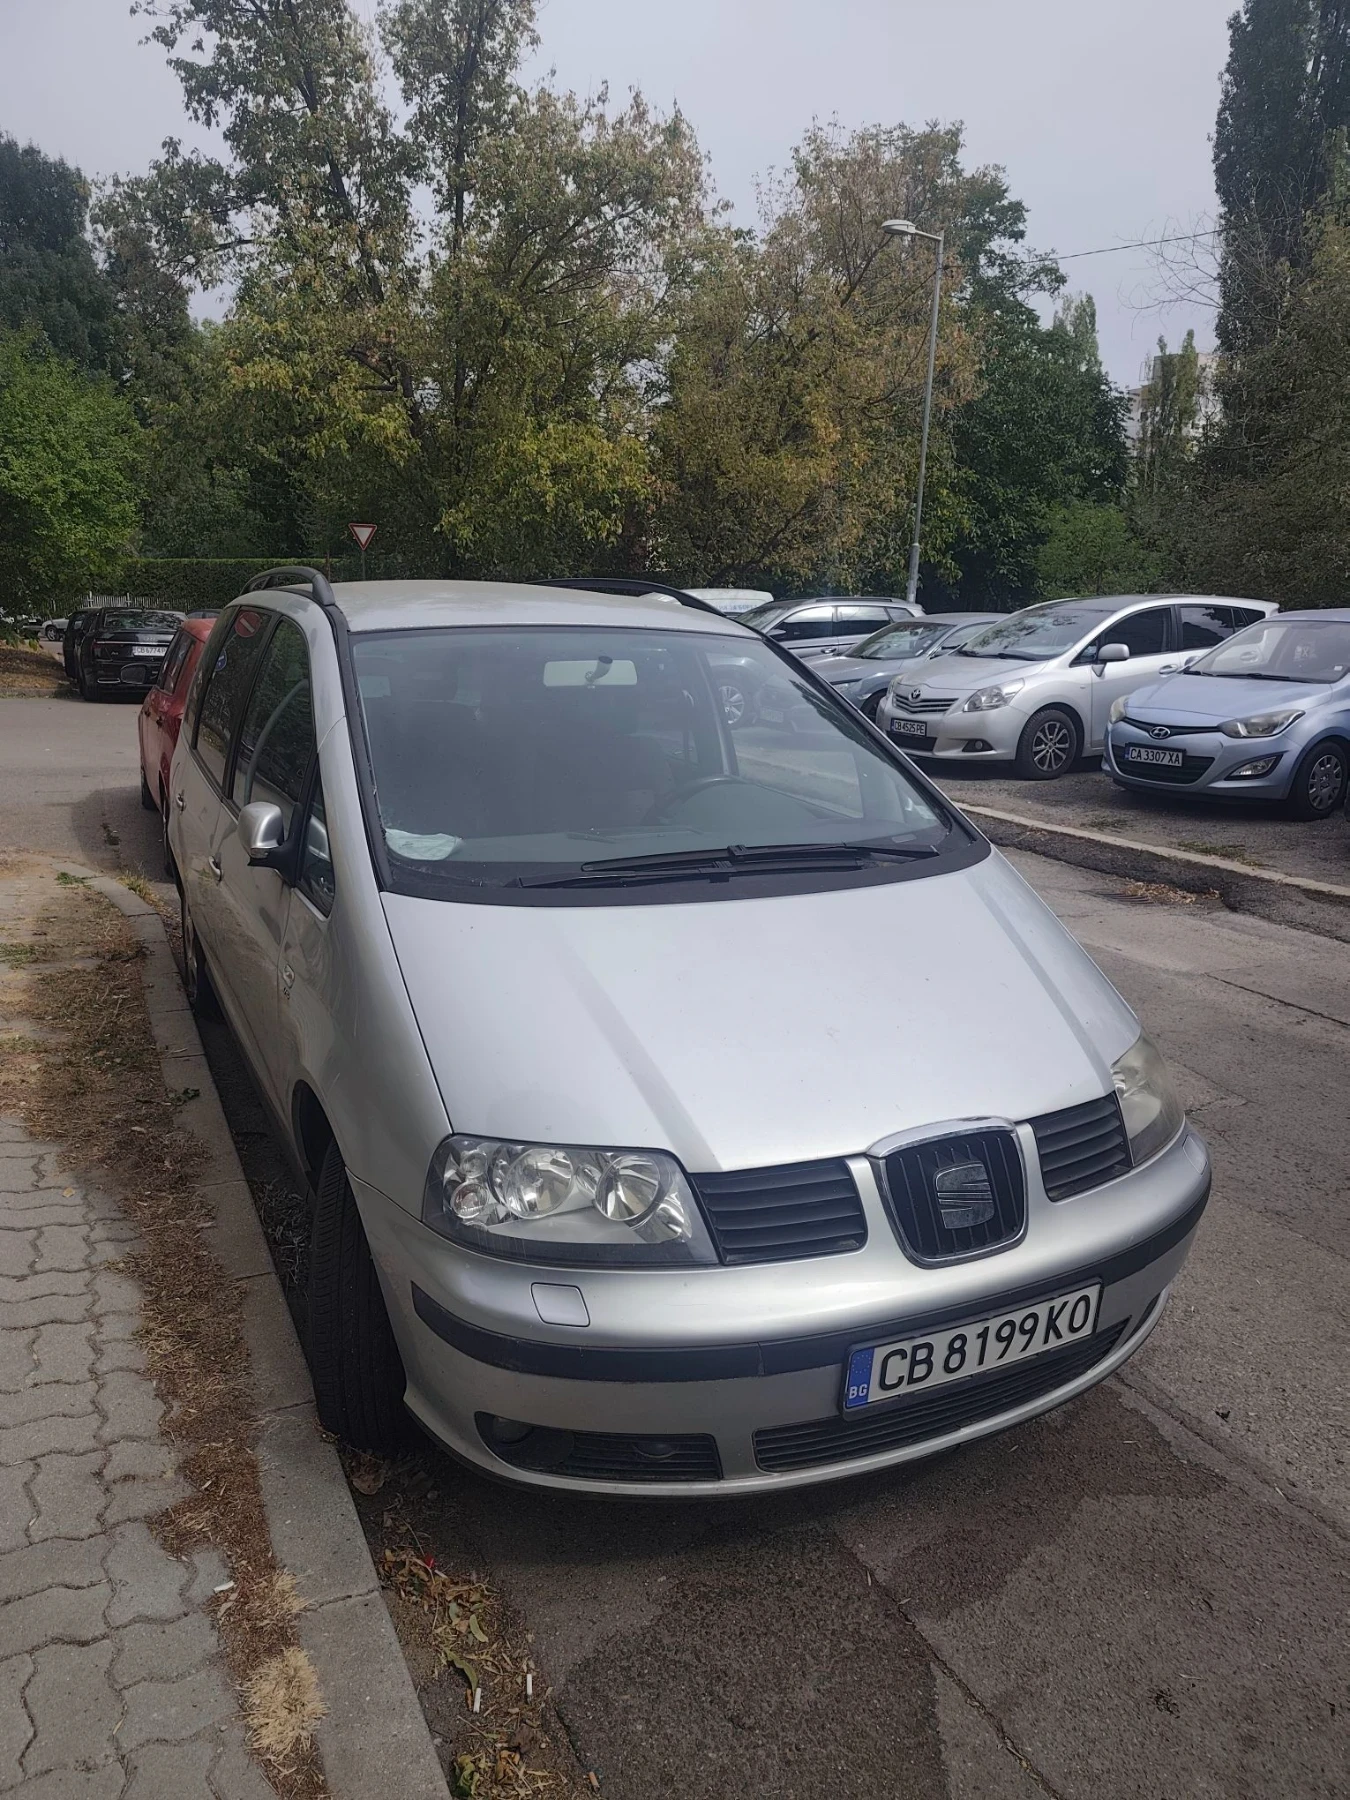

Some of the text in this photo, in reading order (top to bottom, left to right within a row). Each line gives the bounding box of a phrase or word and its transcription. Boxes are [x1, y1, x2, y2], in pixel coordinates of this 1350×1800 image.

[894, 721, 925, 734] CB 4525 PE
[1130, 748, 1180, 765] CA 3307 XA
[849, 1384, 868, 1400] BG
